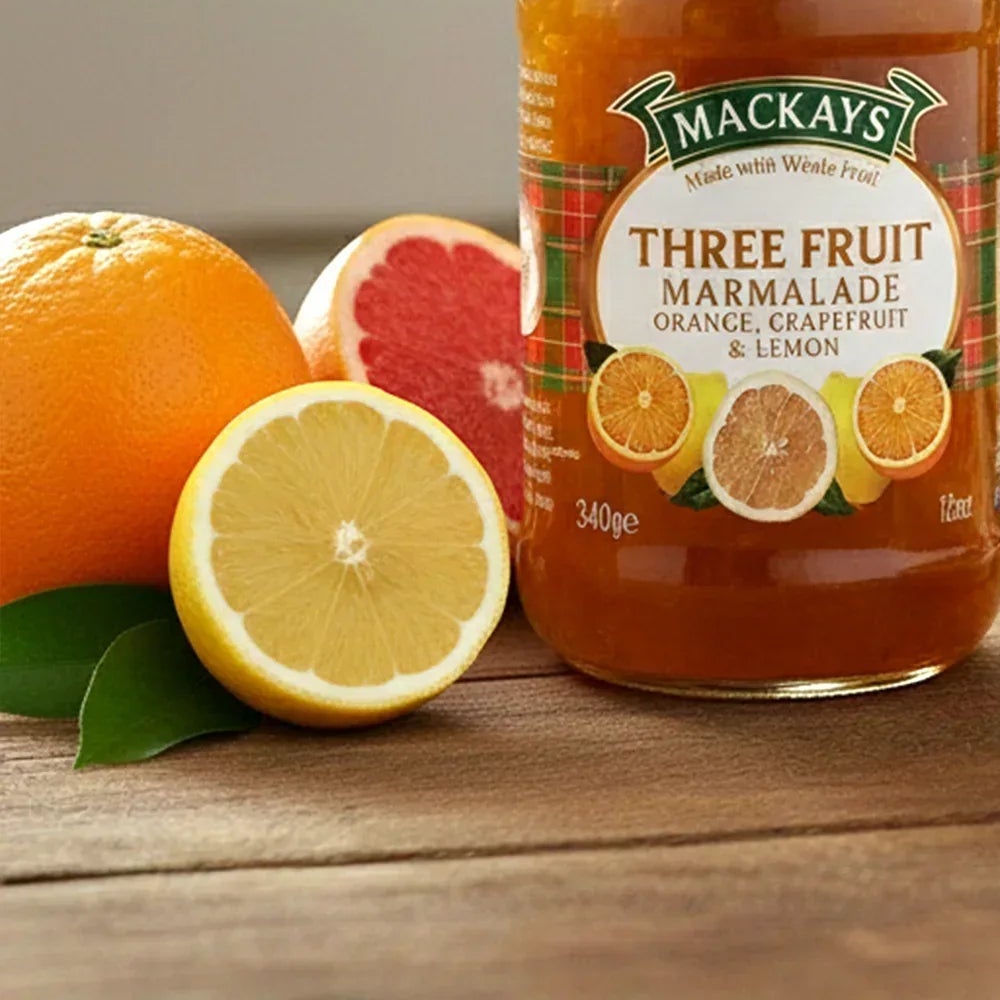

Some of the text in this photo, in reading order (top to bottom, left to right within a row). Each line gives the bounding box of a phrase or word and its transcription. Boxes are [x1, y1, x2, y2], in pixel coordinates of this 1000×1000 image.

[672, 92, 890, 150] MACKAYS
[684, 164, 733, 193] Made
[629, 222, 932, 269] THREE FRUIT
[662, 273, 901, 307] MARMALADE
[728, 337, 840, 358] & LEMON
